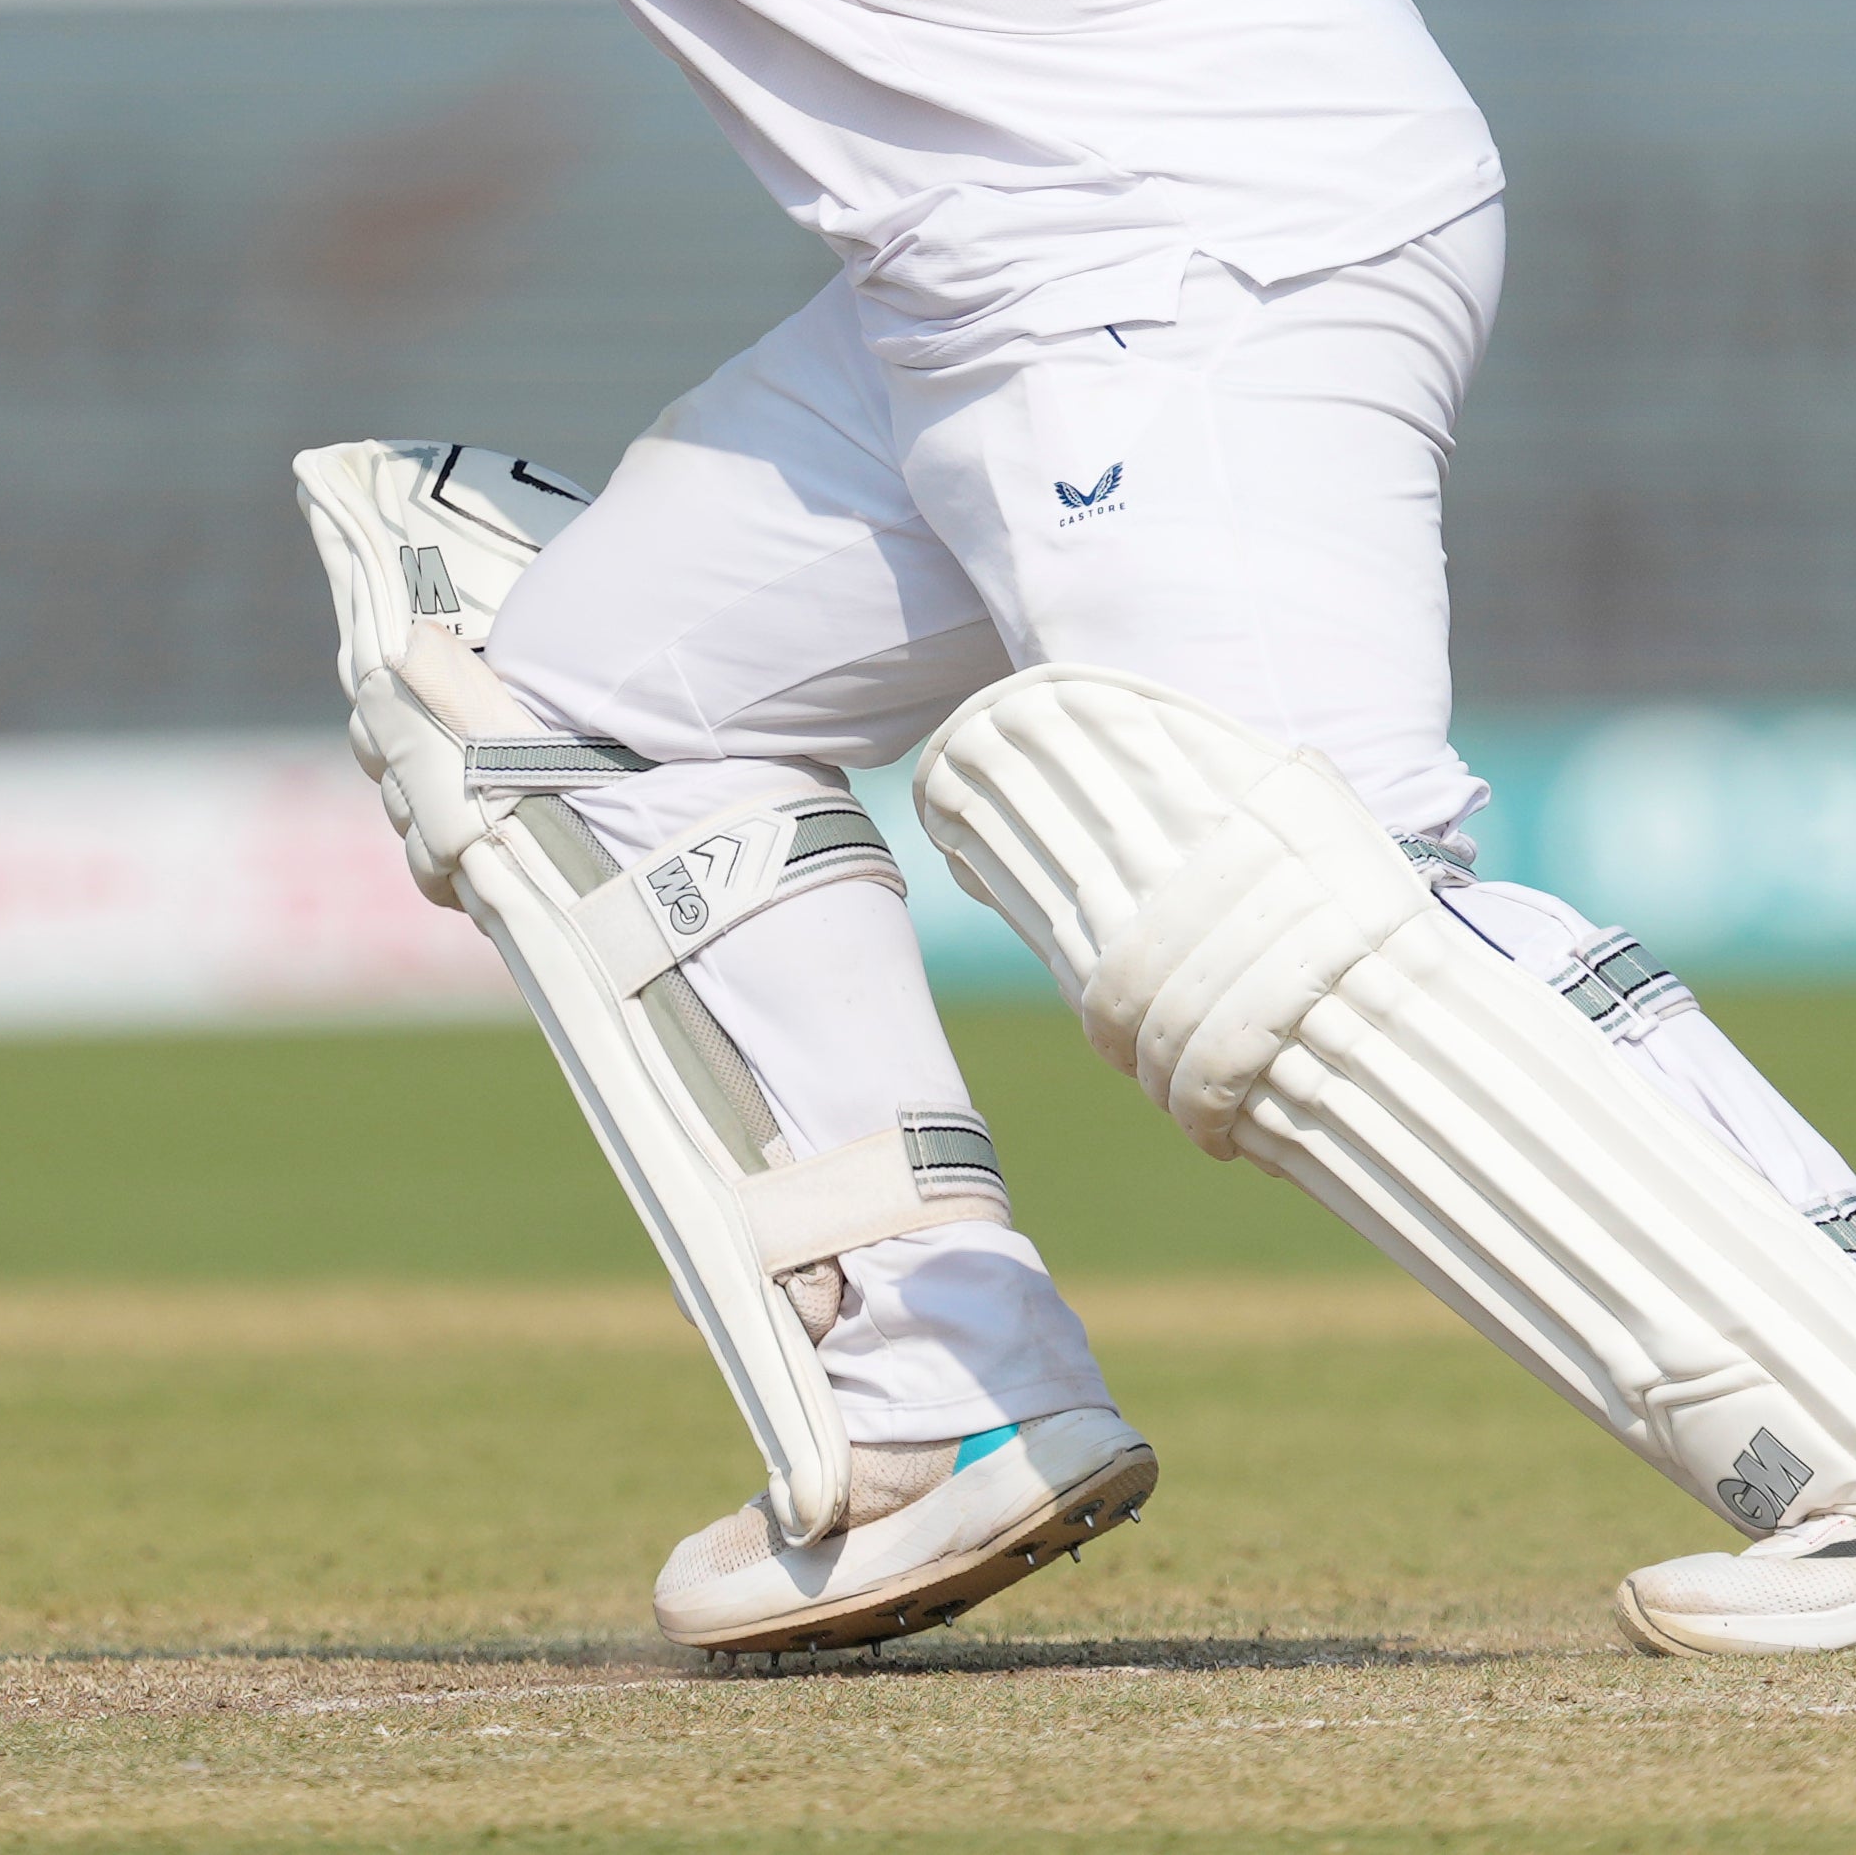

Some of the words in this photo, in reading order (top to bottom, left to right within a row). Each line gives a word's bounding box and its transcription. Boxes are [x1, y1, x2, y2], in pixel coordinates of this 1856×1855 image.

[1058, 501, 1127, 528] CASTORE
[646, 855, 709, 936] GM
[1716, 1426, 1815, 1531] GM
